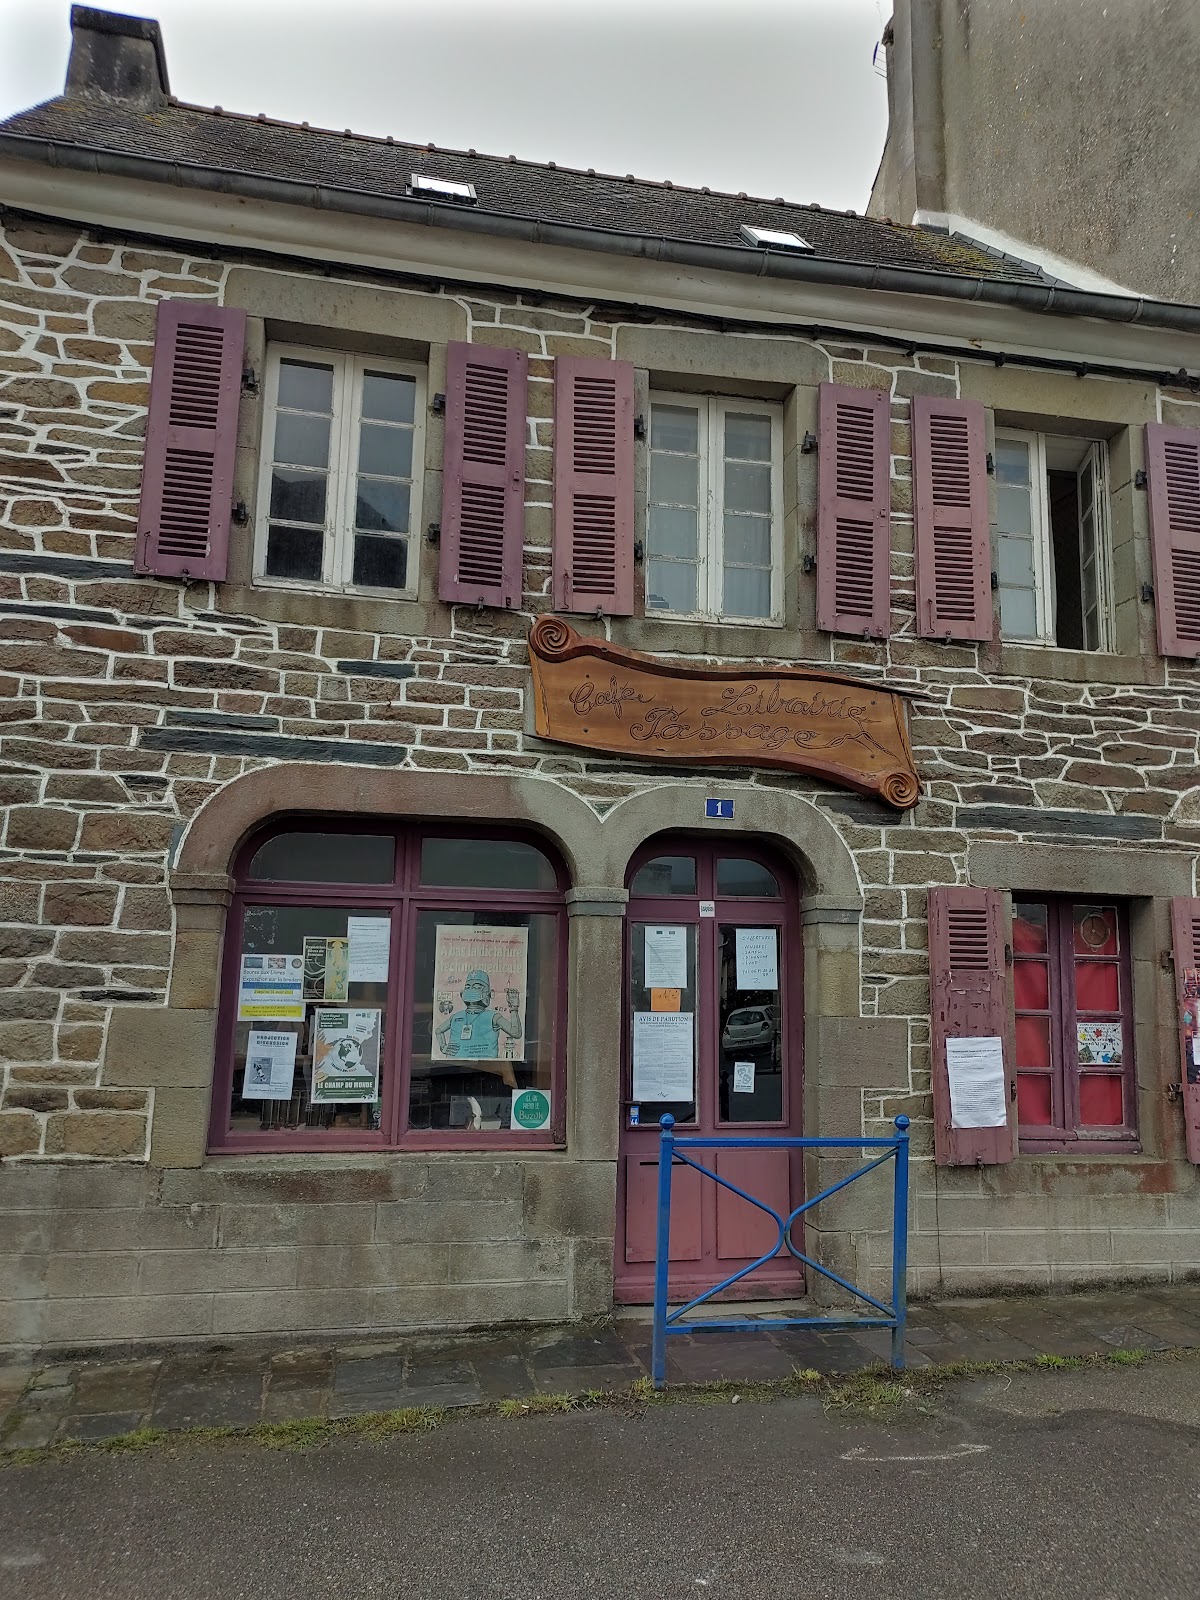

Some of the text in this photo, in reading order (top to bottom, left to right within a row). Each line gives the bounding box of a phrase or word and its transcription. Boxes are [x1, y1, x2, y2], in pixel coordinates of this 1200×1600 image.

[569, 674, 867, 720] Café Librairie
[630, 706, 818, 749] Passage
[715, 803, 723, 816] 1
